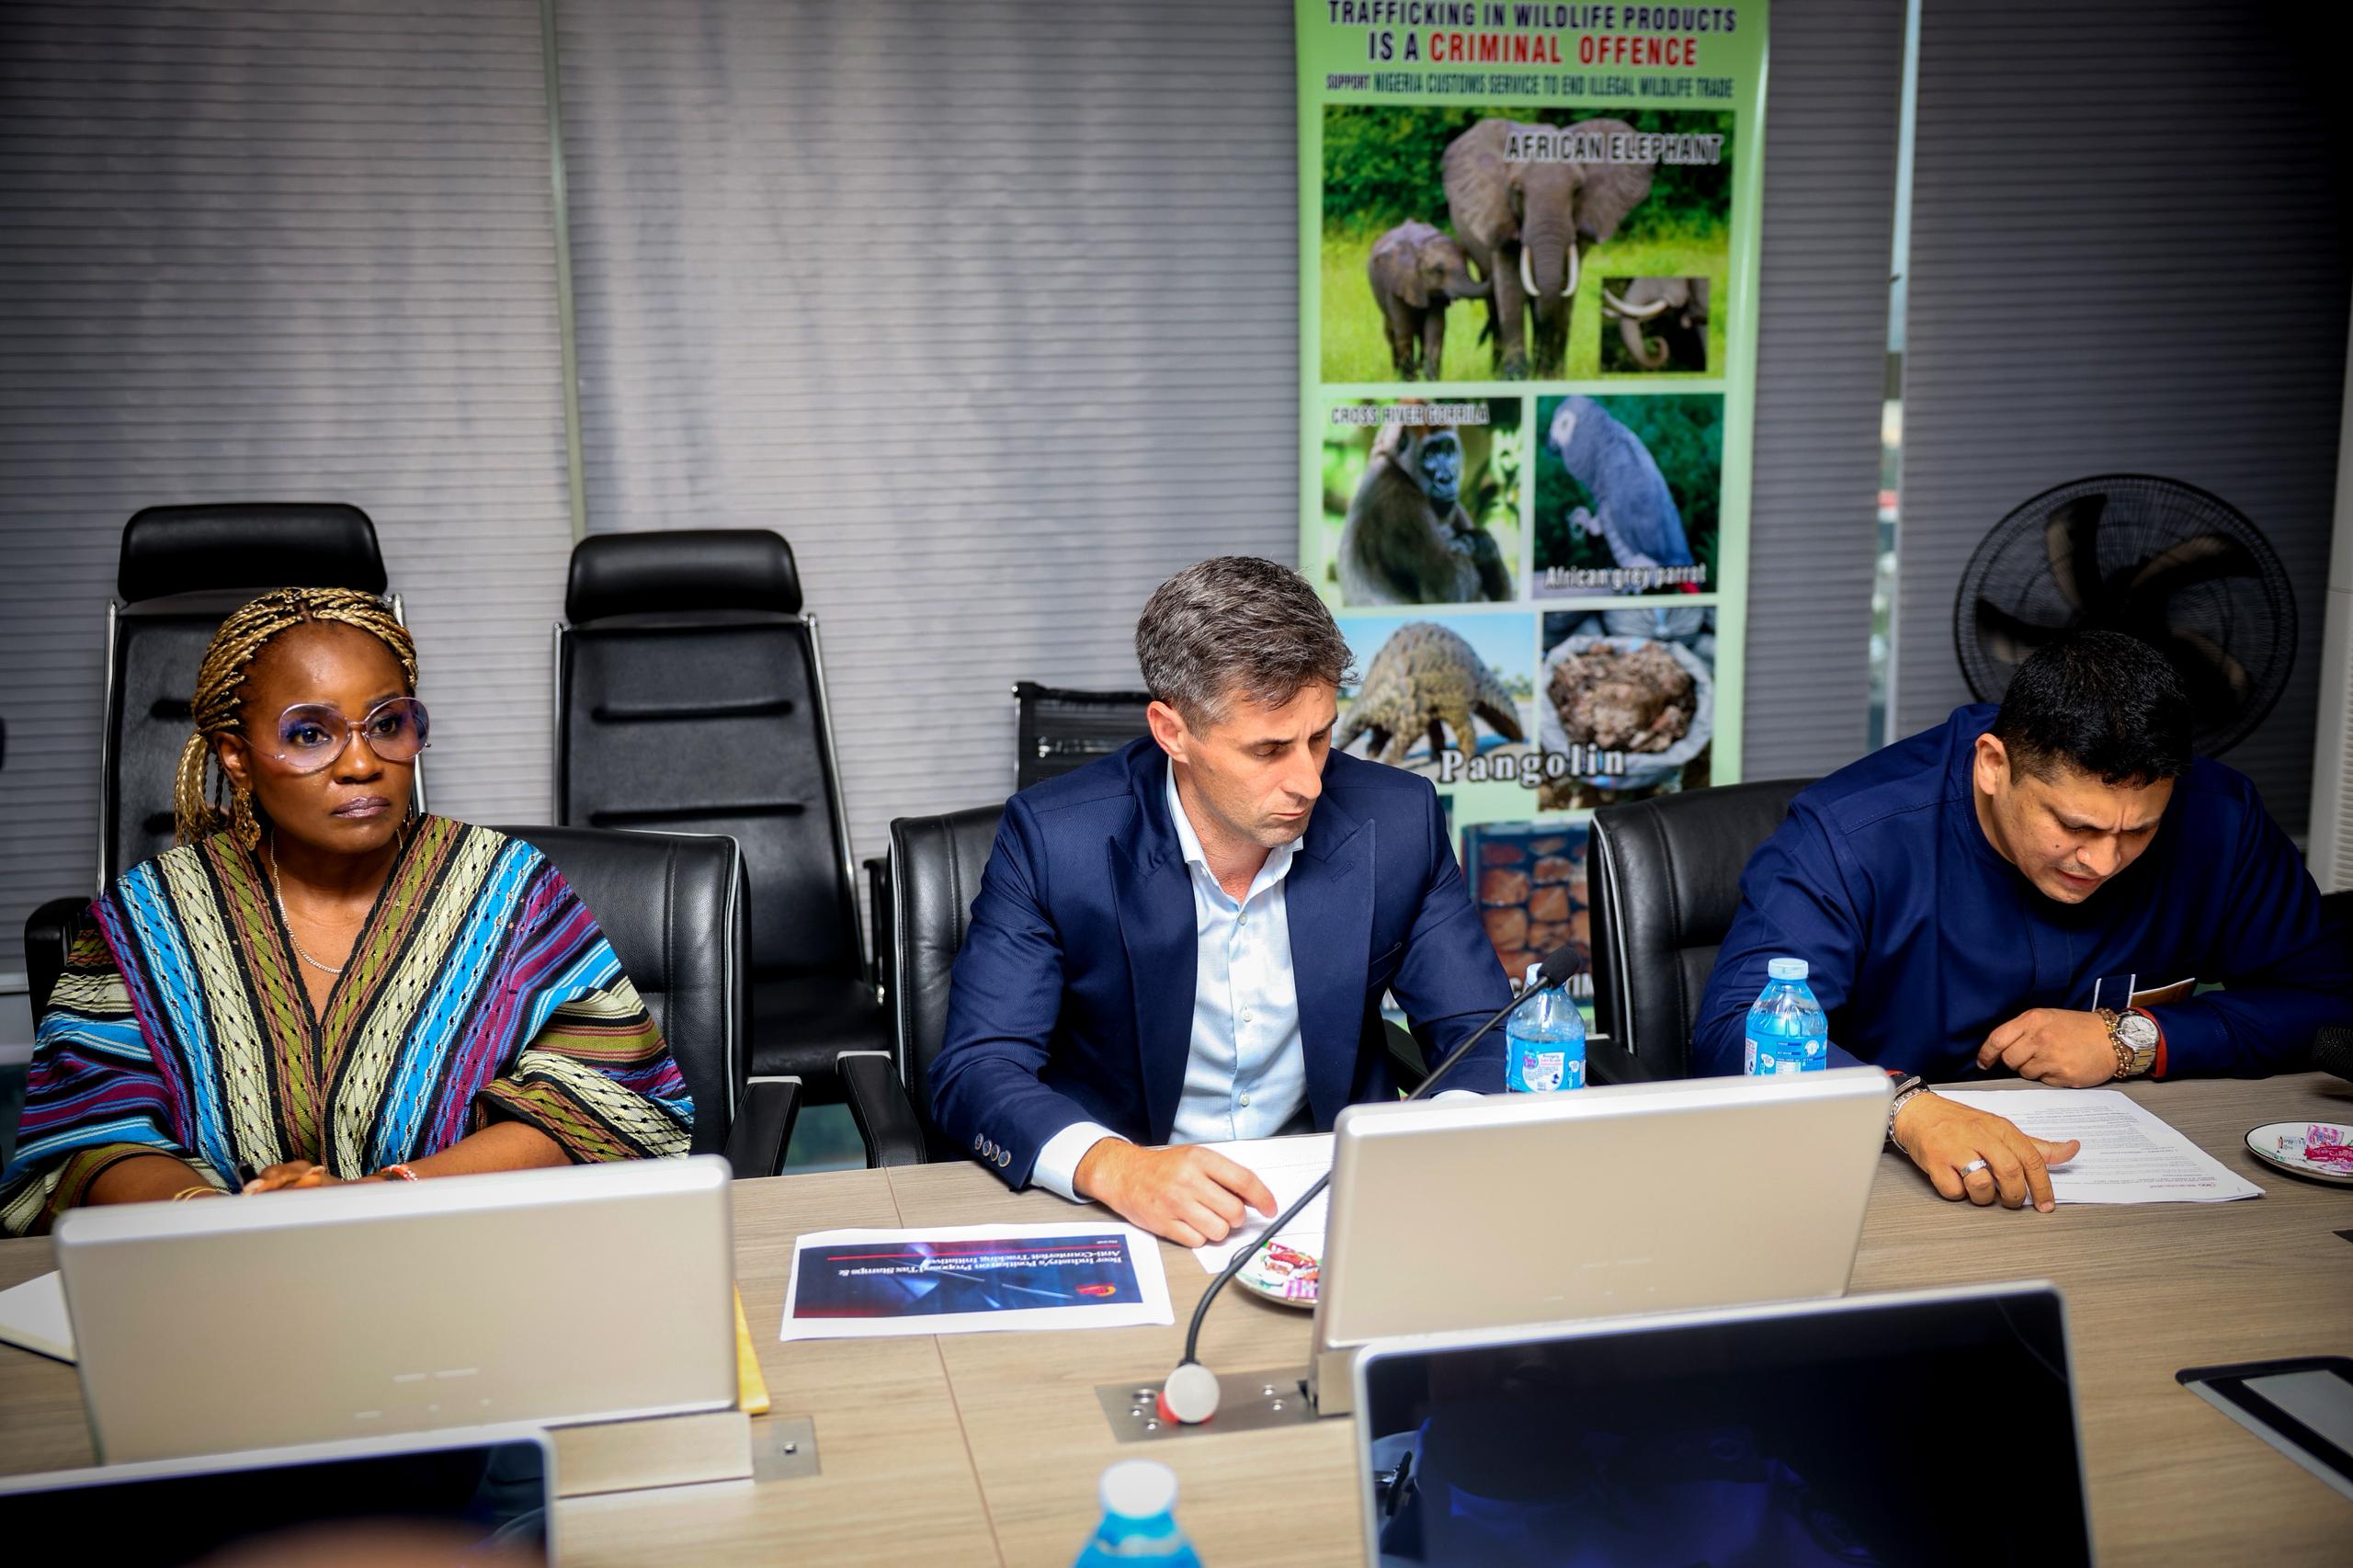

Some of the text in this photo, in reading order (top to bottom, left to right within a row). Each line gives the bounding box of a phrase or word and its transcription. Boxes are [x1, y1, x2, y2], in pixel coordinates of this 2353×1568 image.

[1328, 0, 1736, 32] TRAFFICKING IN WILDLIFE PRODUCTS
[1370, 31, 1698, 66] IS A CRIMINAL OFFENCE
[1326, 72, 1734, 98] SUPPORT NIGERIA CUSTOMS SERVICE TO END ILLEGAL WILDLIFE TRADE
[1504, 131, 1724, 165] AFRICAN ELEPHANT
[1331, 404, 1379, 426] CROSS
[1381, 404, 1426, 426] RIVER
[1544, 562, 1708, 591] African grey parrot
[1439, 743, 1625, 788] Pangolin
